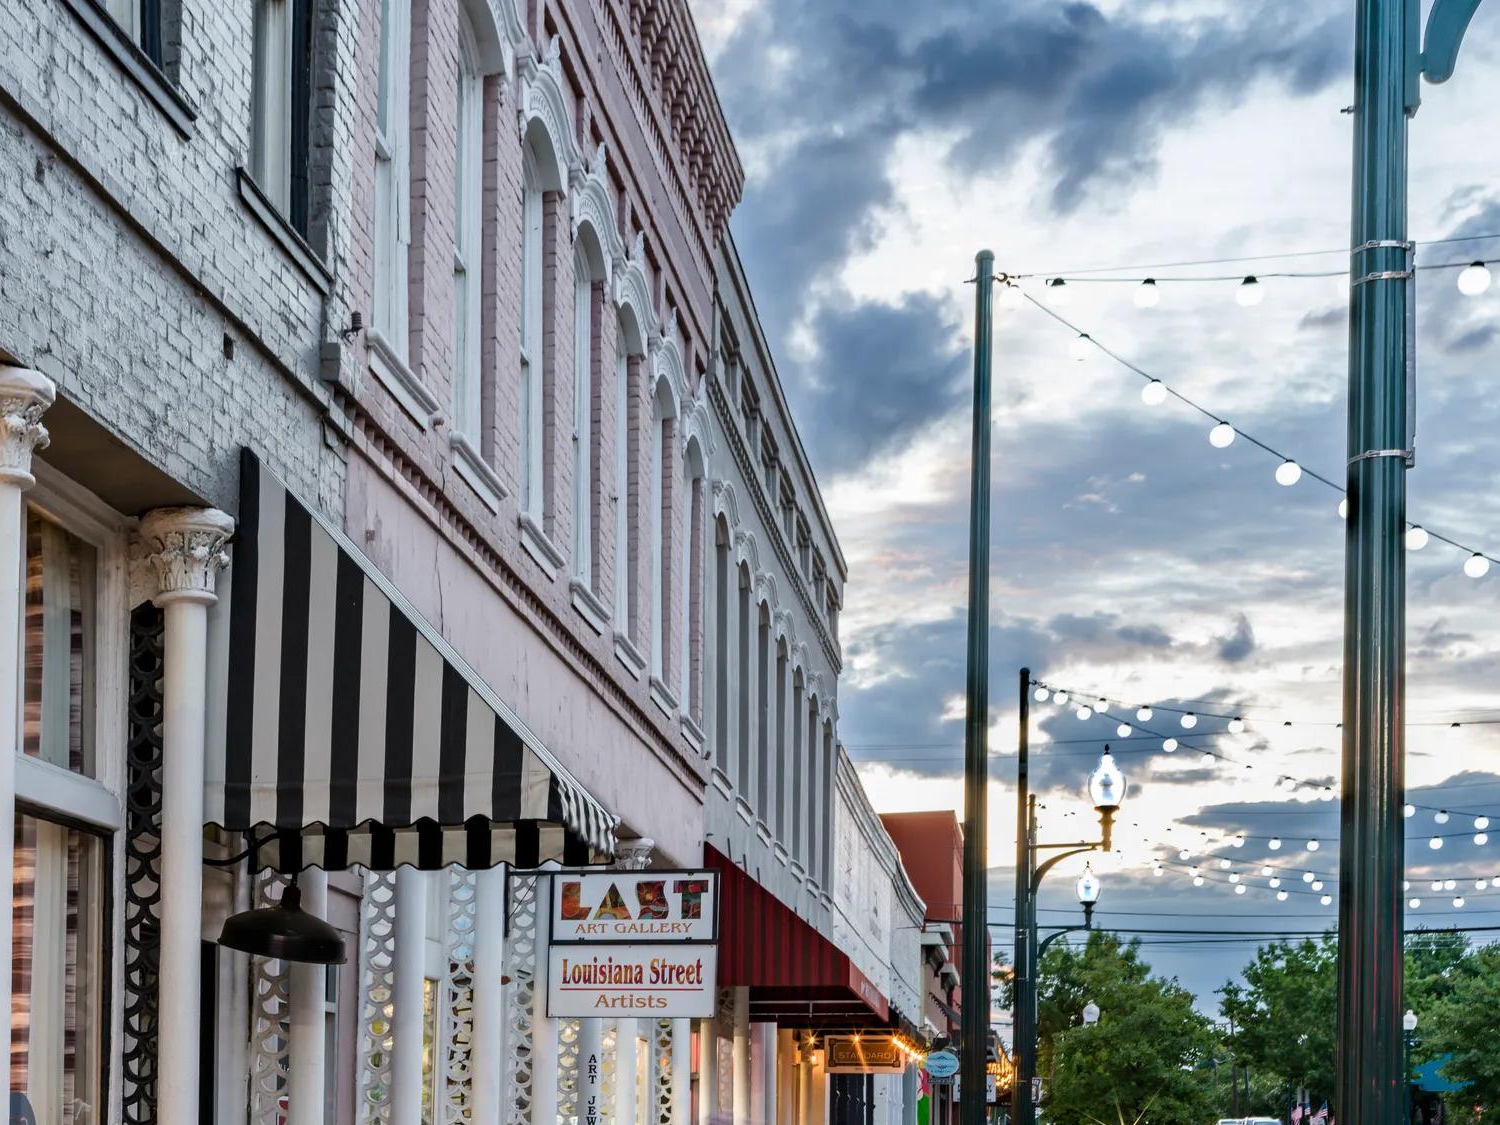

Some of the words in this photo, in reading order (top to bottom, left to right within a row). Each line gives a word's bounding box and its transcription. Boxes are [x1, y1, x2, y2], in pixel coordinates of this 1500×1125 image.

[560, 880, 709, 921] LAST
[575, 923, 609, 934] ART
[614, 922, 693, 934] GALLERY
[562, 956, 643, 985] Louisiana
[649, 957, 703, 985] Street
[594, 994, 668, 1009] Artists
[588, 1054, 597, 1085] ART
